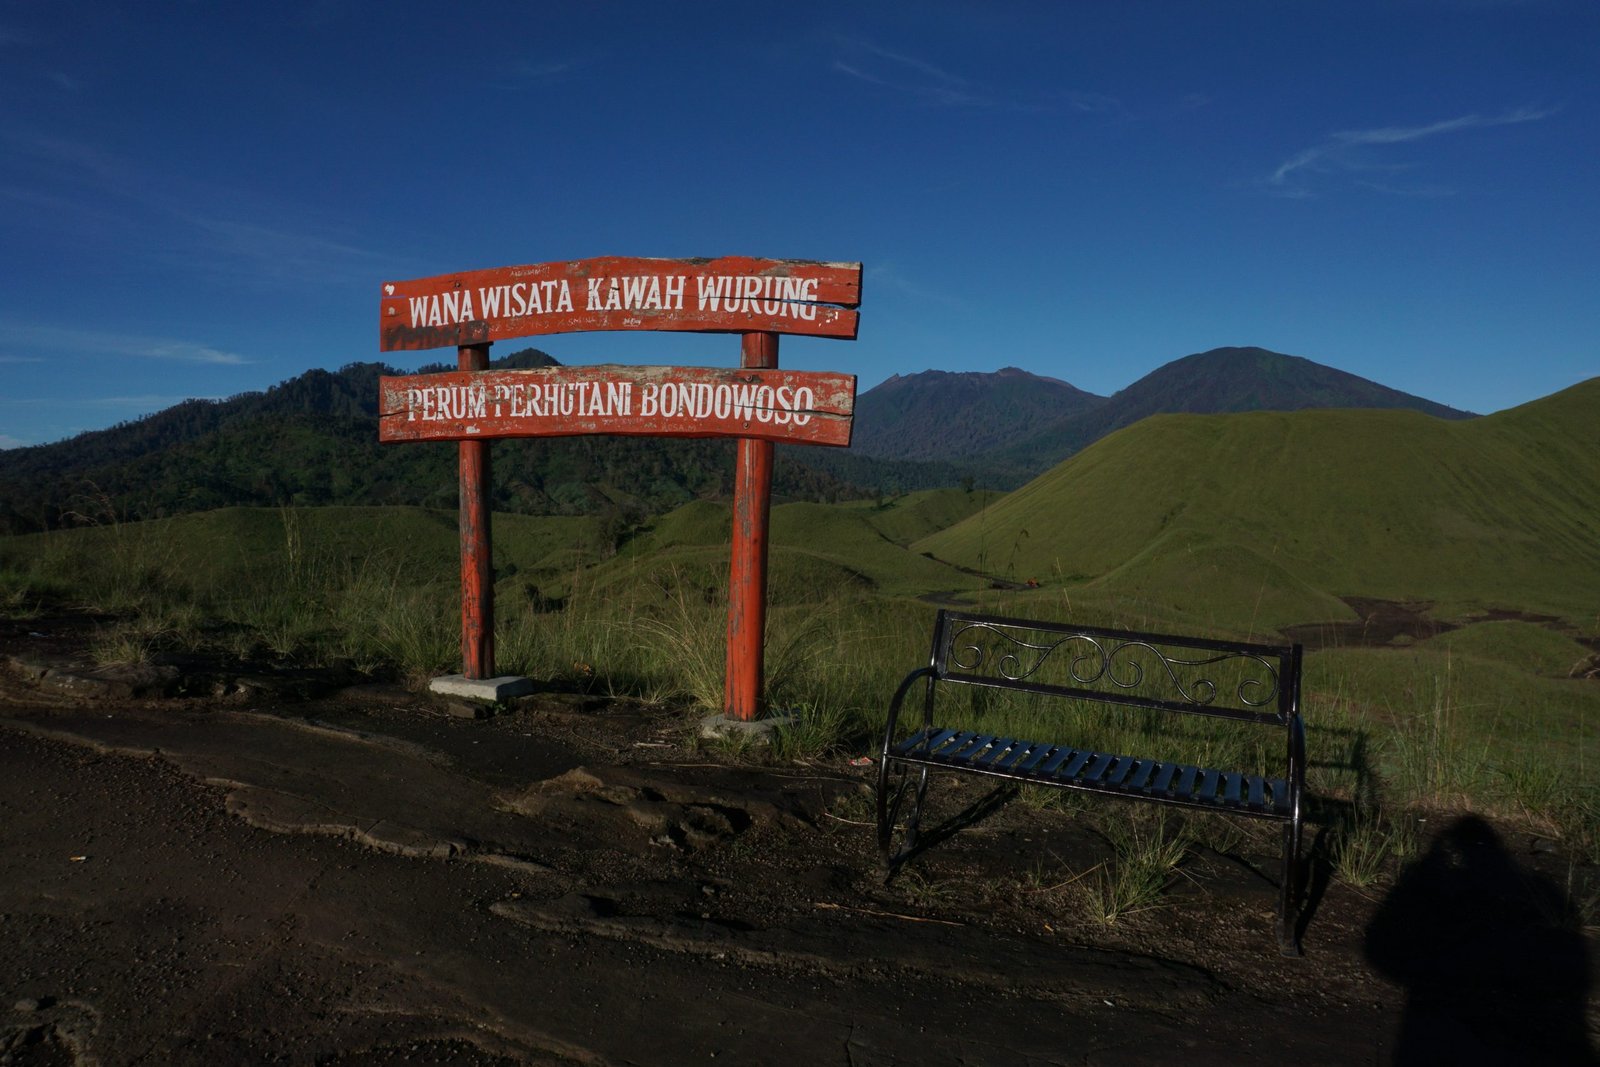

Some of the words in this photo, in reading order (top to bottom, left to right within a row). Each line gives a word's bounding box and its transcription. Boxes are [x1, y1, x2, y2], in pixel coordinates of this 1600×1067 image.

[409, 289, 475, 328] WANA
[479, 279, 574, 319] WISATA
[586, 275, 686, 311] KAWAH
[696, 275, 819, 321] WURUNG
[407, 386, 487, 422] PERUM
[494, 381, 633, 418] PERHUTANI
[640, 382, 814, 426] BONDOWOSO
